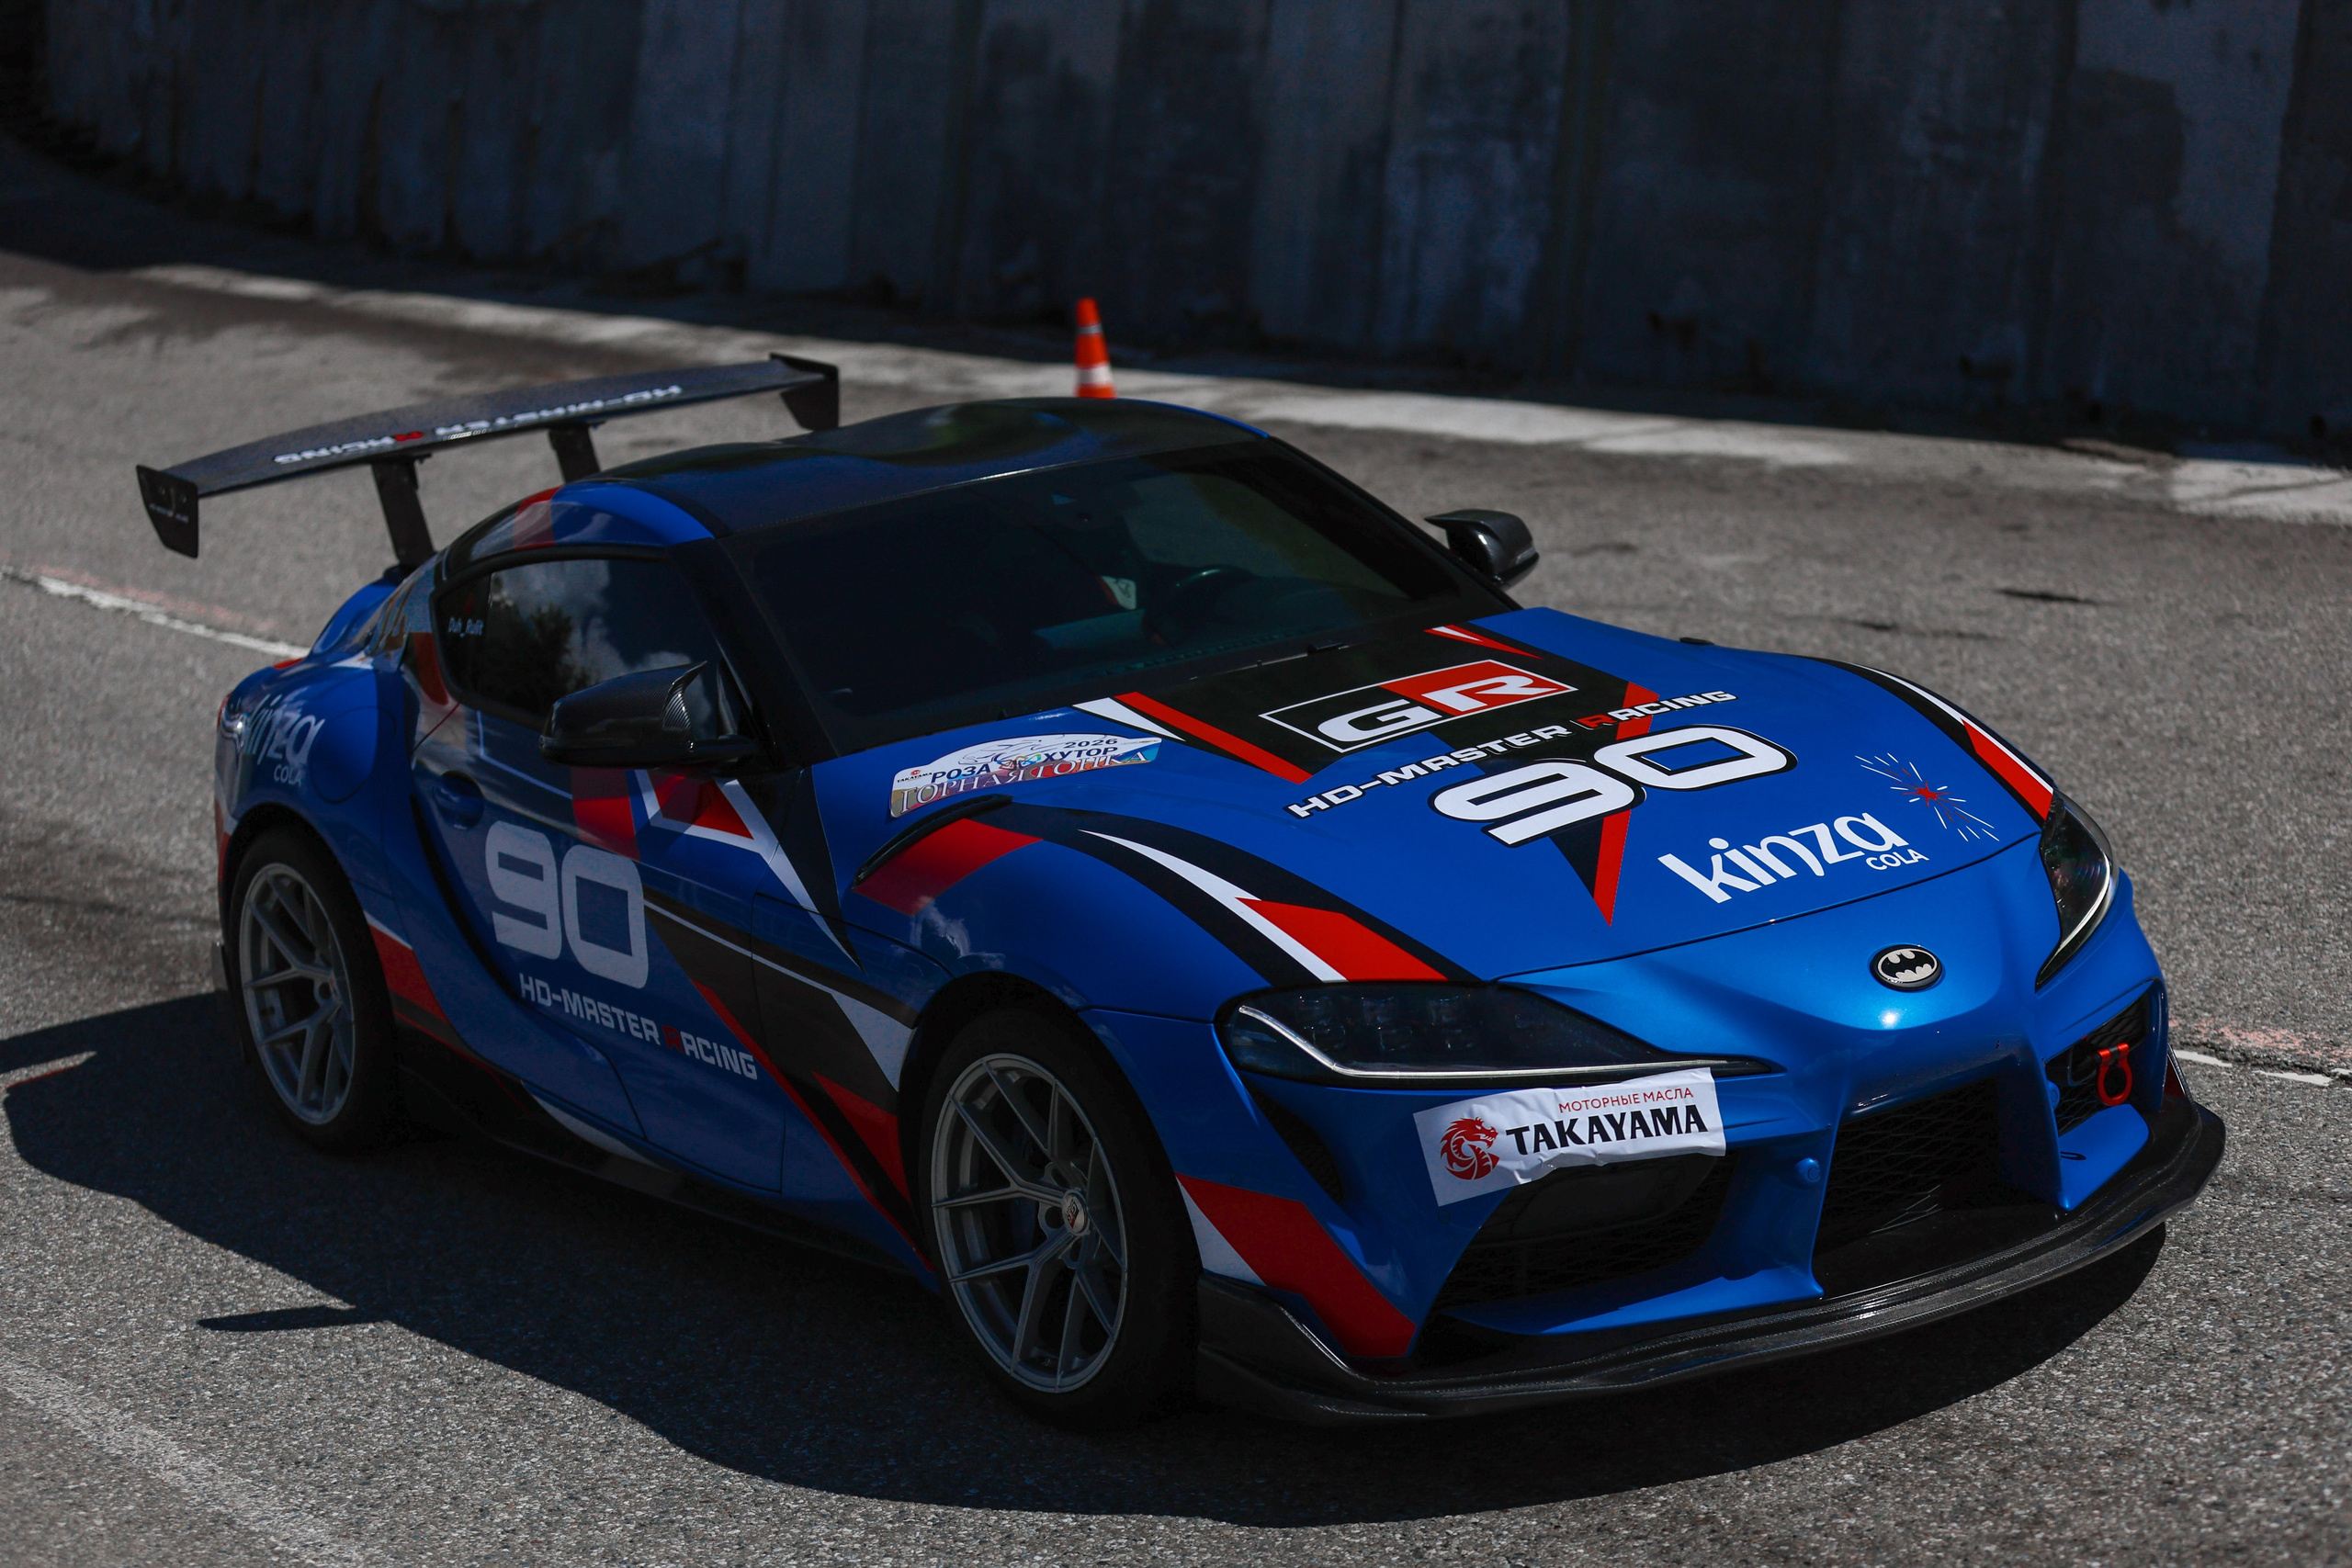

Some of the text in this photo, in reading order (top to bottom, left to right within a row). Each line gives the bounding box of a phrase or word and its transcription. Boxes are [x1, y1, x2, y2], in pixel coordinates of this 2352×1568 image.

[1317, 674, 1556, 743] GR
[931, 747, 1118, 783] РОЗА ХУТОР
[1064, 738, 1118, 749] 2026
[1286, 690, 1737, 818] HD-MASTER RACING
[274, 764, 302, 787] COLA
[897, 772, 933, 783] TAKAYAMA
[899, 768, 1026, 814] ГОРНАЯ
[1430, 725, 1793, 847] 90
[1657, 812, 1910, 904] kinza
[1865, 848, 1930, 871] COLA
[484, 819, 650, 989] 90
[519, 972, 758, 1081] HD-MASTER RACING
[1558, 1087, 1694, 1114] МОТОРНЫЕ МАСЛА
[1505, 1104, 1709, 1156] TAKAYAMA
